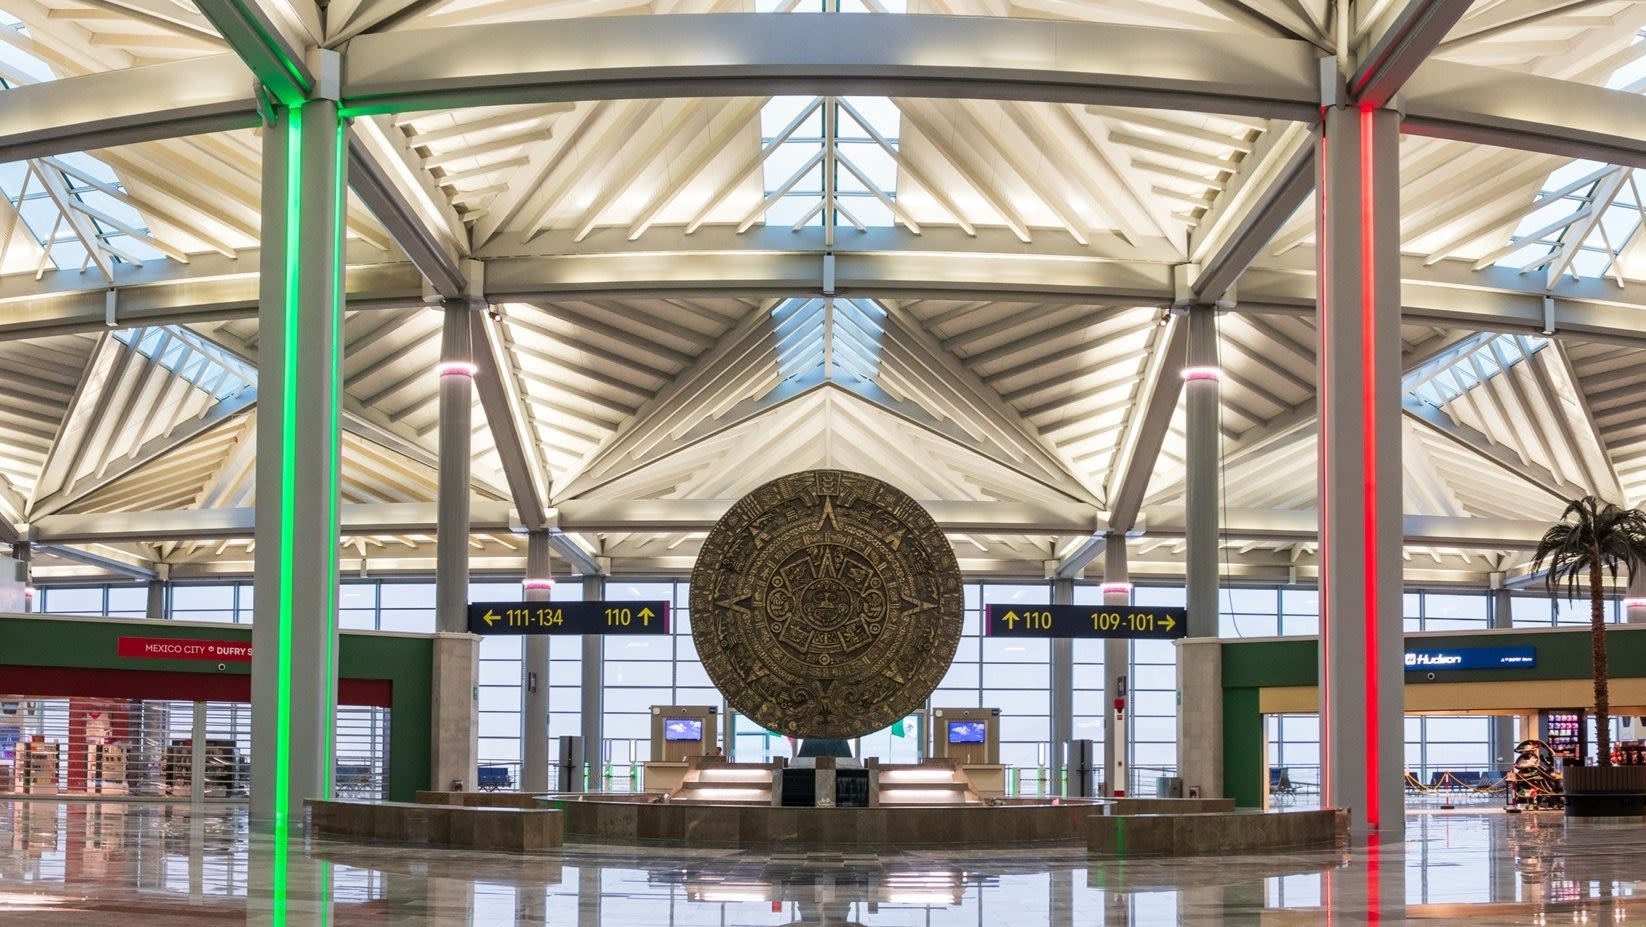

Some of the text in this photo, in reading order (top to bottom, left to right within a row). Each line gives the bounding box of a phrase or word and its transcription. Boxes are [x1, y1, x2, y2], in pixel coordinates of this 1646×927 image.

[506, 608, 563, 626] 111-134
[604, 608, 631, 626] 110
[1023, 611, 1052, 629] 110
[1090, 612, 1154, 631] 109-101
[145, 644, 182, 654] MEXICO
[183, 645, 205, 654] CITY
[216, 646, 247, 656] DUFRY
[1416, 653, 1462, 665] Hudson
